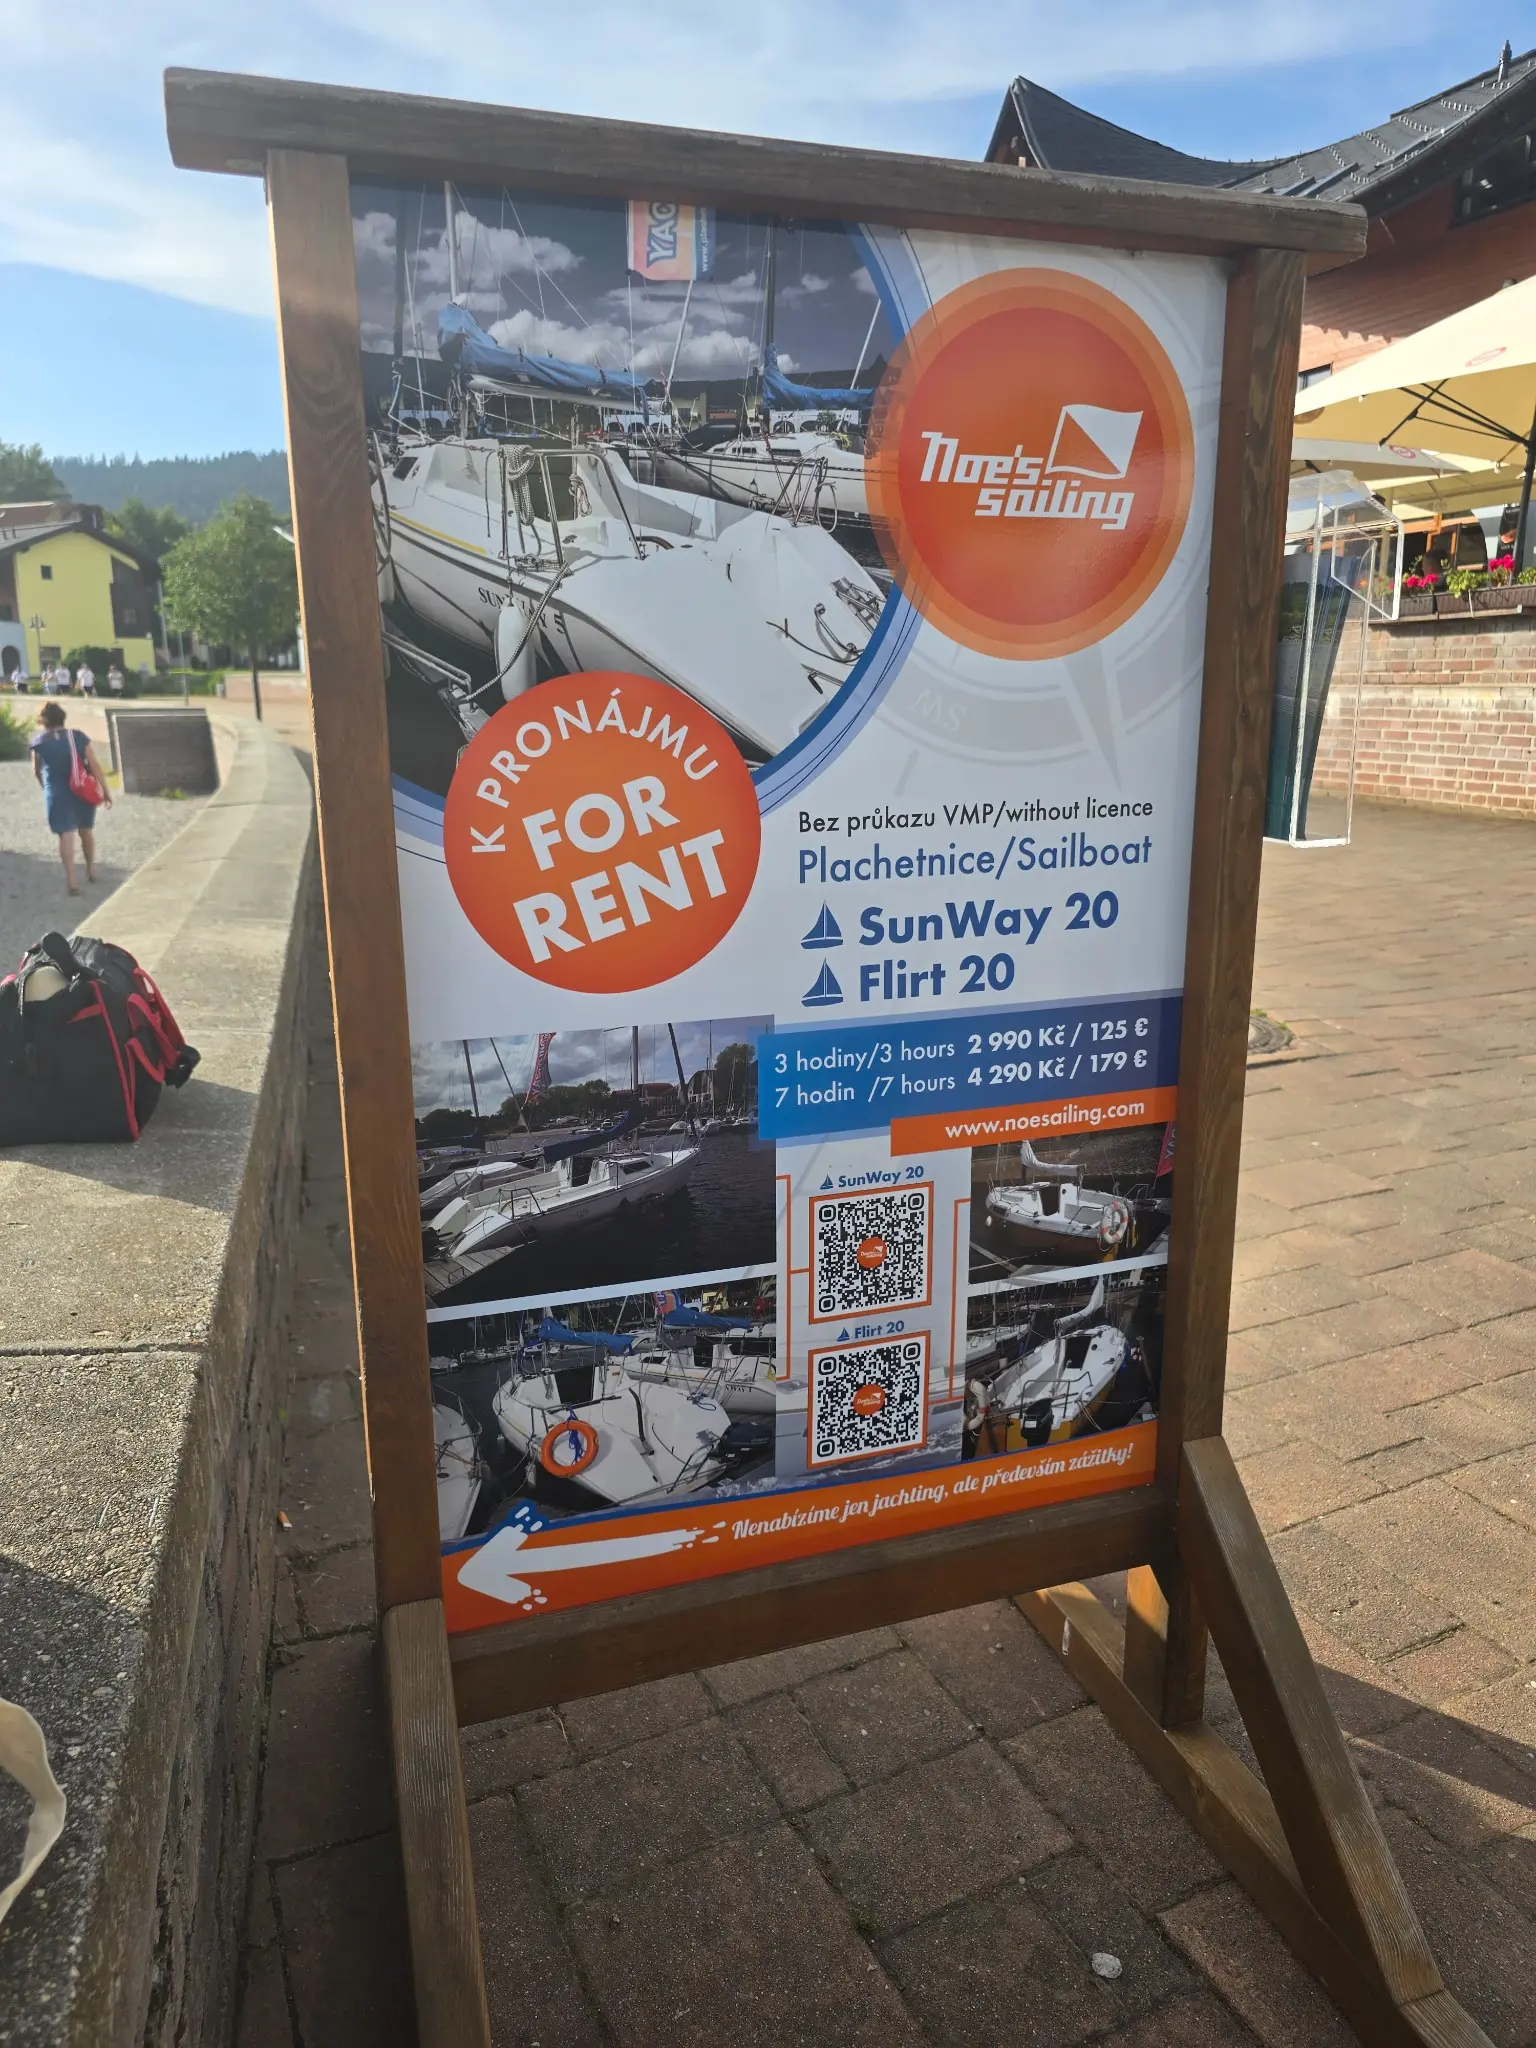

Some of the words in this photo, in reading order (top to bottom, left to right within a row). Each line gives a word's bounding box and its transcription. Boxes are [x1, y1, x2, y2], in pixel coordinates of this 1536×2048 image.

[975, 480, 1134, 529] sailing
[476, 687, 719, 809] PRONÁJMU
[469, 824, 506, 853] K
[522, 775, 680, 872] FOR
[799, 811, 839, 833] Bez
[847, 806, 936, 837] průkazu
[943, 799, 1080, 828] VMP/without
[1086, 797, 1154, 820] licence
[798, 831, 1153, 884] Plachetnice/Sailboat
[513, 828, 728, 964] RENT
[859, 899, 1053, 946] SunWay
[1065, 890, 1120, 931] 20
[860, 959, 946, 1002] Flirt
[959, 952, 1015, 994] 20
[774, 1053, 788, 1074] 3
[796, 1043, 892, 1072] hodiny/3
[901, 1041, 955, 1062] hours
[967, 1034, 983, 1055] 2
[989, 1029, 1033, 1051] 990
[1038, 1025, 1065, 1048] Kč
[1089, 1020, 1128, 1042] 125
[1134, 1017, 1149, 1037] €
[775, 1088, 788, 1108] 7
[796, 1083, 855, 1106] hodin
[868, 1076, 894, 1103] /7
[901, 1073, 956, 1095] hours
[967, 1066, 983, 1087] 4
[989, 1060, 1033, 1084] 290
[1038, 1057, 1065, 1079] Kč
[1089, 1051, 1128, 1074] 179
[1133, 1049, 1148, 1068] €
[944, 1099, 1146, 1140] www.noesailing.com
[838, 1170, 902, 1189] SunWay
[905, 1165, 924, 1181] 20
[854, 1324, 883, 1339] Flirt
[886, 1320, 905, 1334] 20
[732, 1505, 839, 1540] Nenabízíme
[839, 1500, 869, 1523] jen
[867, 1484, 949, 1517] jachting,
[952, 1474, 980, 1494] ale
[981, 1457, 1066, 1494] především
[1068, 1442, 1134, 1471] zážitky!
